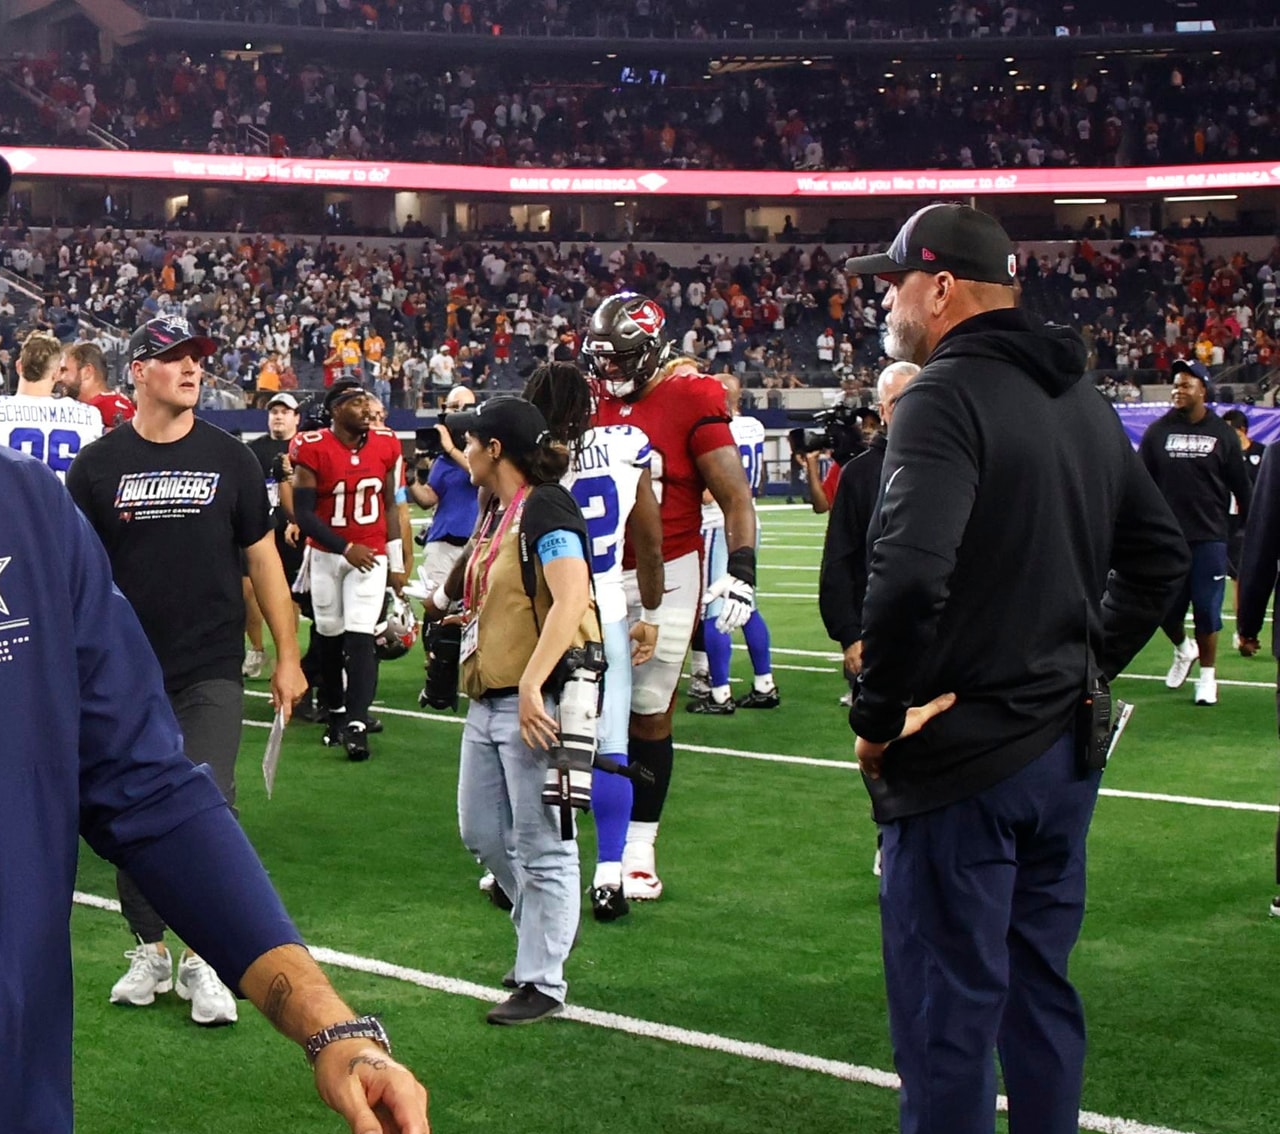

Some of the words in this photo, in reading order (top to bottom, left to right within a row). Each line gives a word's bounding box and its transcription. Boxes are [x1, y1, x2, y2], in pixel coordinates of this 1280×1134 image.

[510, 178, 549, 190] BANK
[550, 178, 571, 190] OF
[572, 179, 637, 190] AMERICA
[120, 476, 213, 502] BUCCANEERS
[330, 477, 383, 527] 10
[520, 532, 529, 562] Canon
[13, 636, 29, 644] FOR
[561, 774, 570, 801] Canon
